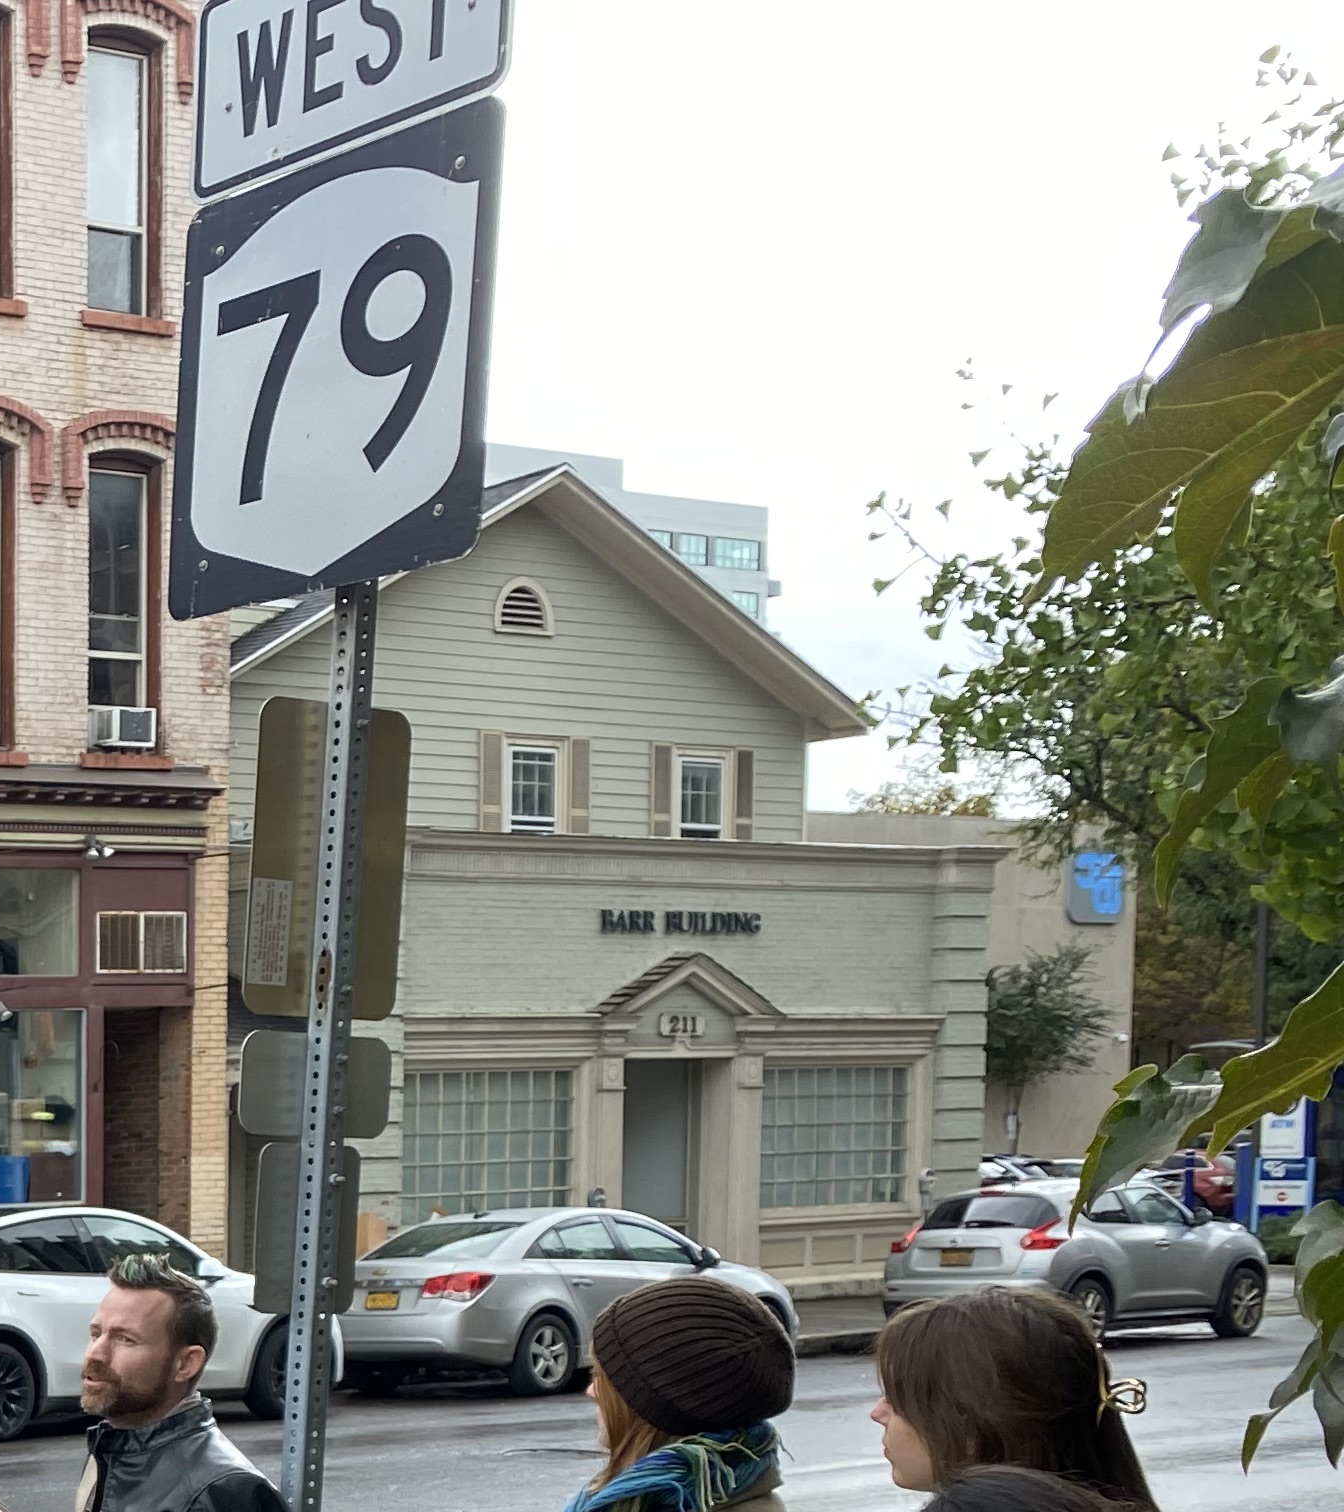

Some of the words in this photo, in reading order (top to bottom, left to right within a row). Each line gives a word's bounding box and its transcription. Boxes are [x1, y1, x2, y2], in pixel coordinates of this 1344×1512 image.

[217, 233, 453, 506] 79
[600, 909, 655, 934] BARR
[665, 911, 761, 936] BUILDING
[669, 1015, 698, 1033] 211
